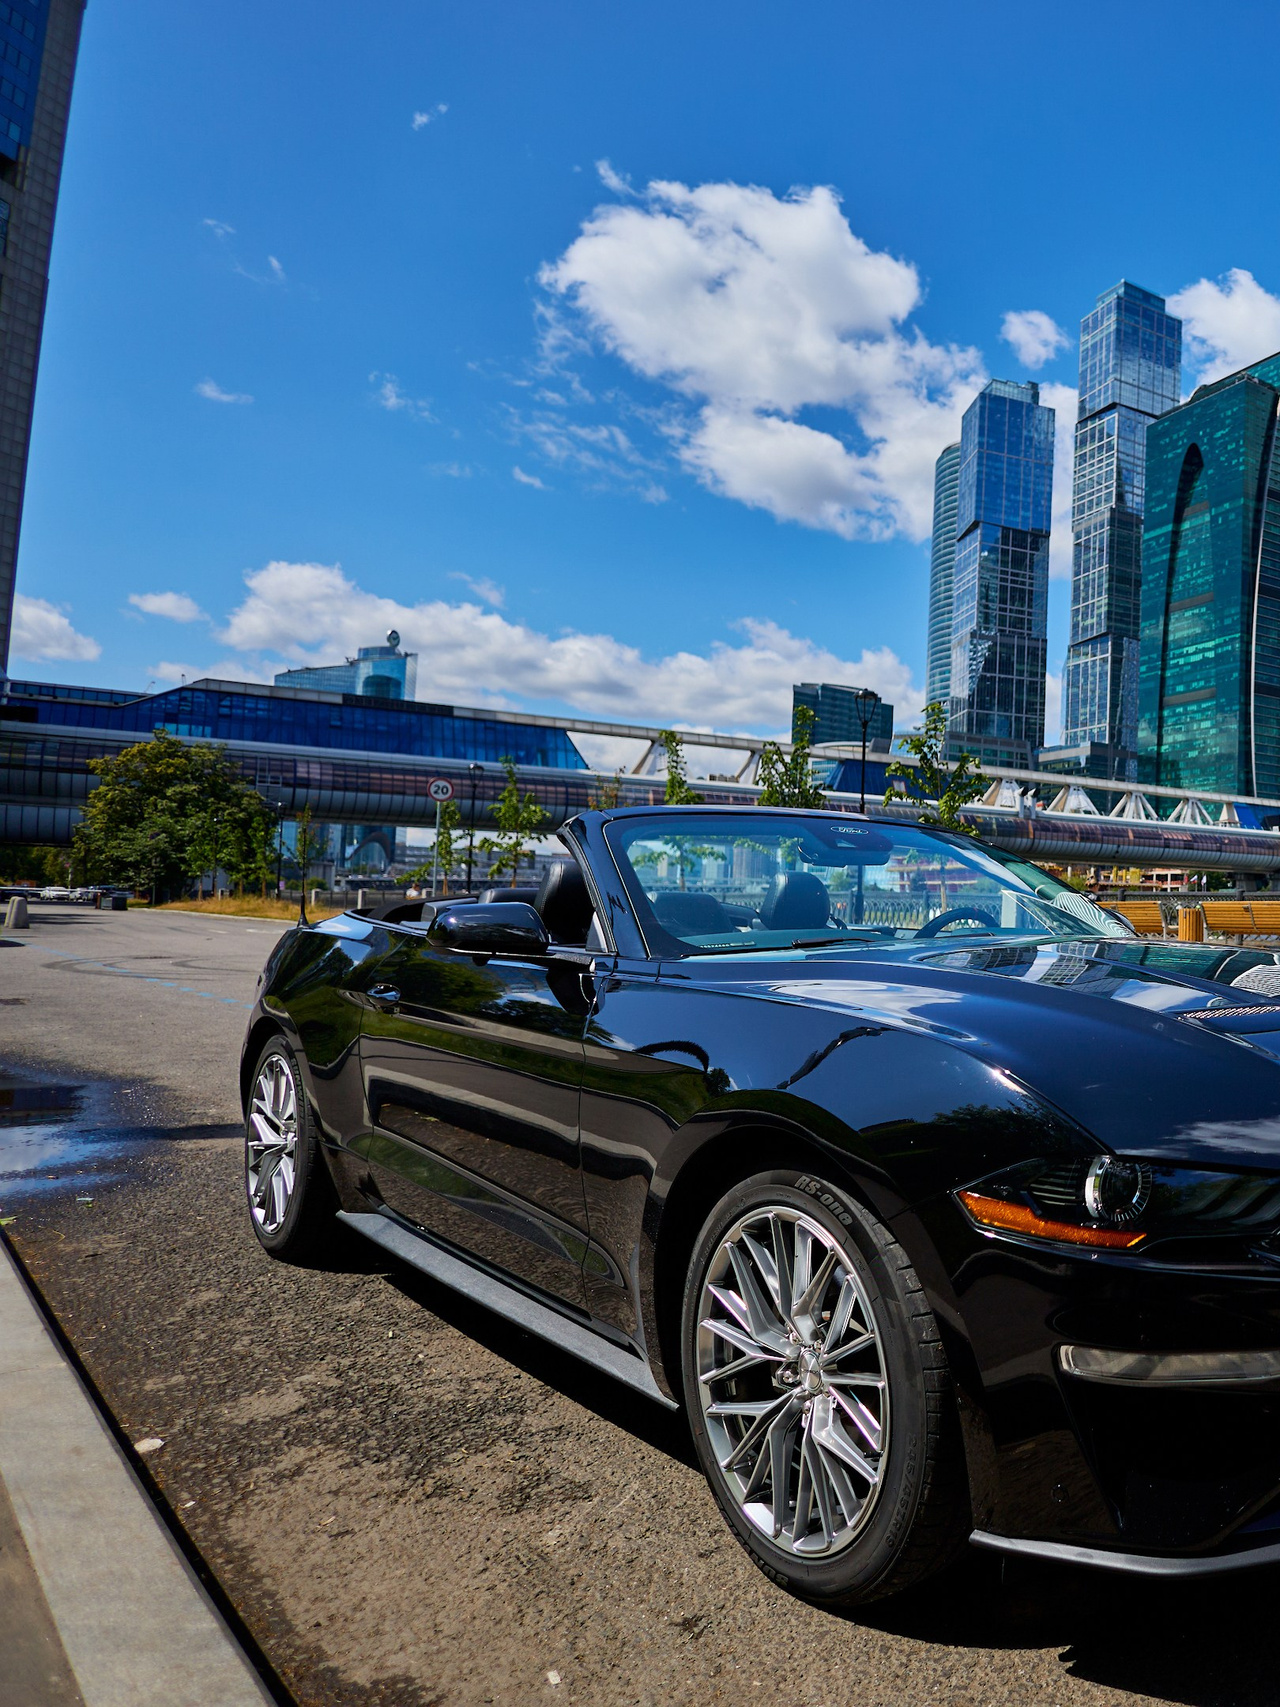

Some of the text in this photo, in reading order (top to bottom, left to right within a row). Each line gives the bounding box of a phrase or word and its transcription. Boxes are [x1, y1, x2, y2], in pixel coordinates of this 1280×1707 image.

[433, 785, 449, 797] 20
[793, 1174, 854, 1226] RS-one
[885, 1432, 918, 1549] 245/45ZR19
